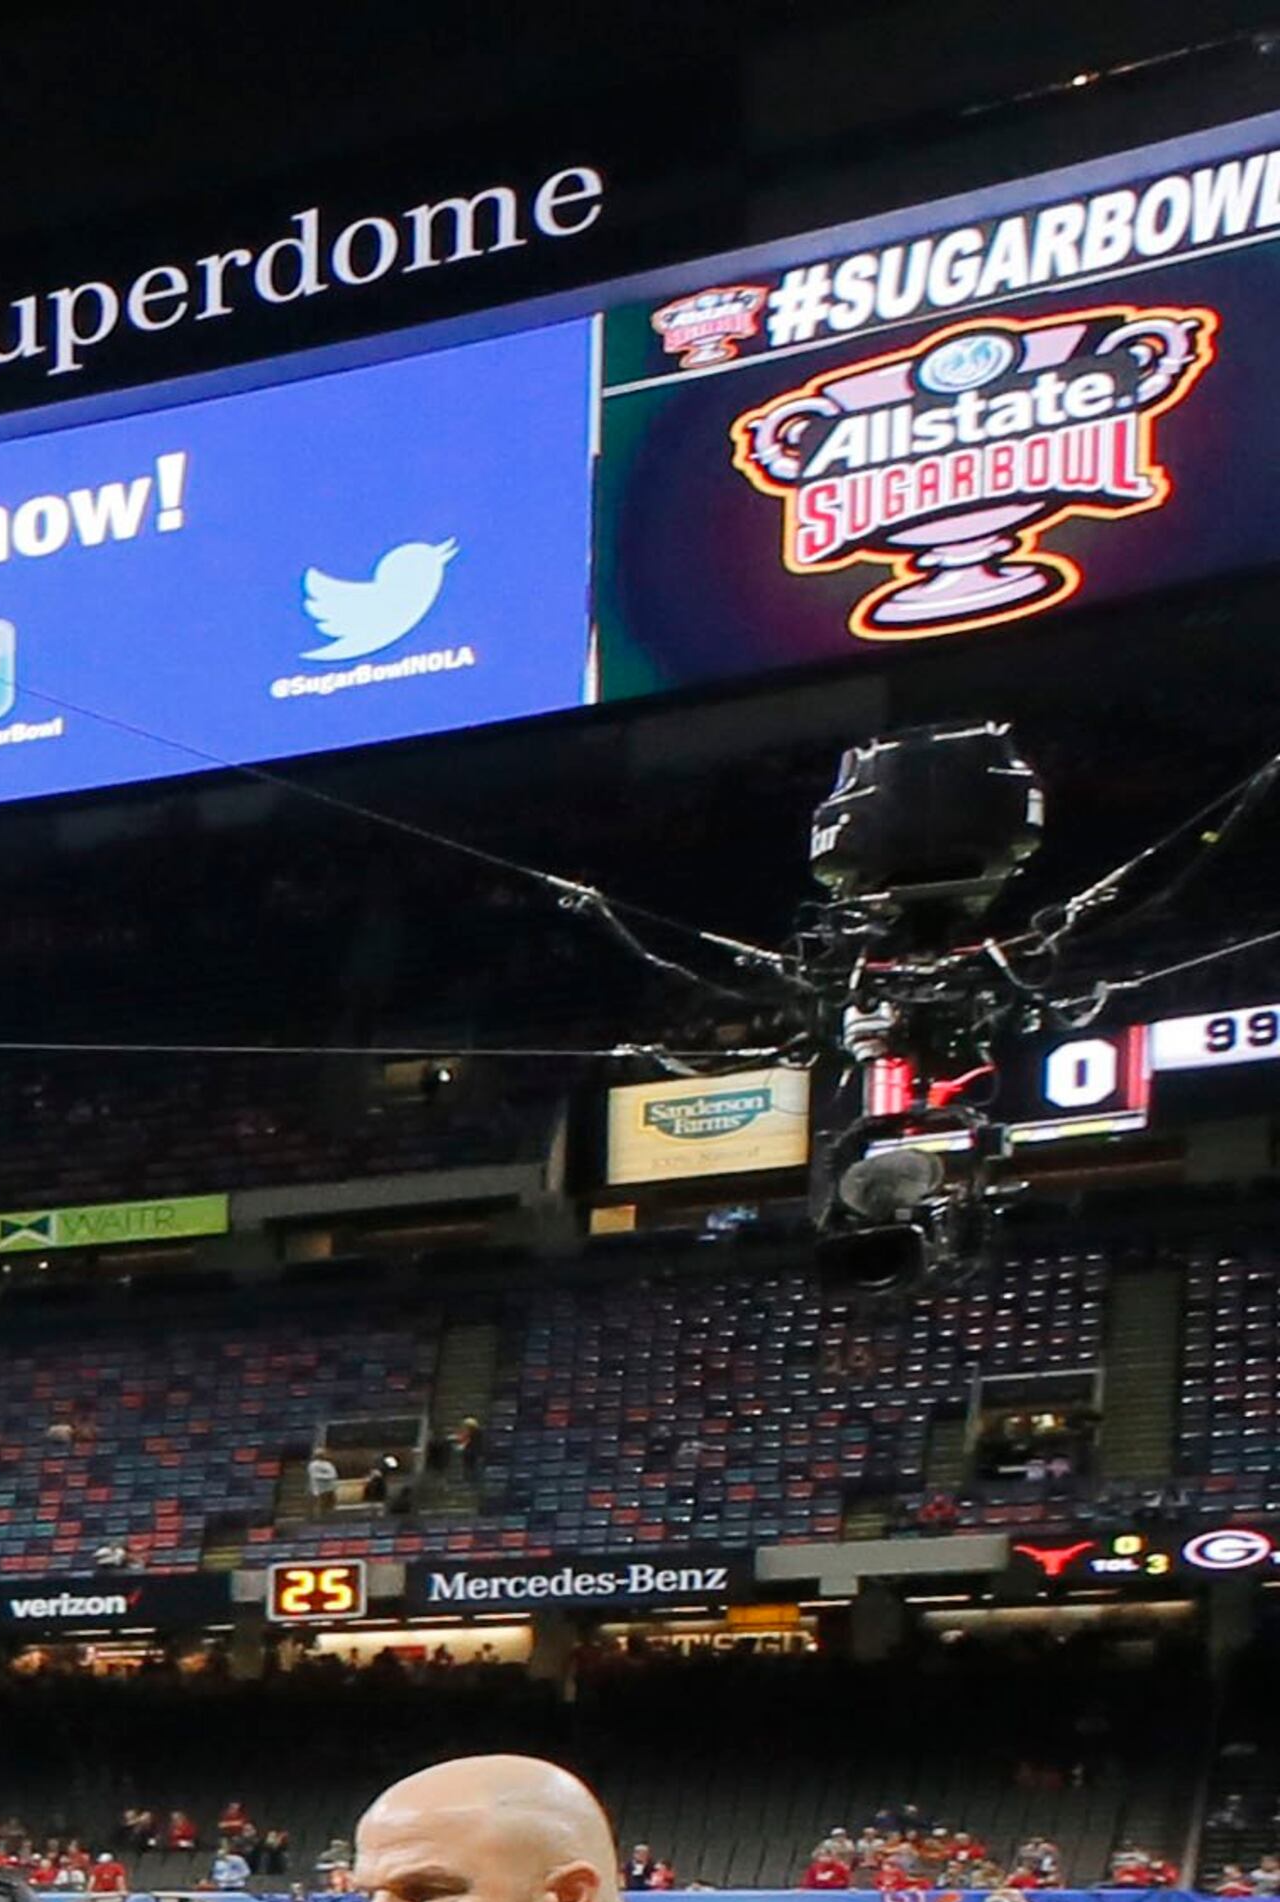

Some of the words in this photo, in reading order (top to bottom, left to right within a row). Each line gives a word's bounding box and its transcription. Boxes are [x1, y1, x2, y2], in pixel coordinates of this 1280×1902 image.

[1045, 1038, 1118, 1109] 0
[649, 1094, 764, 1122] Sanderson
[672, 1114, 742, 1135] Farms
[280, 1569, 354, 1614] 25
[430, 1564, 728, 1602] Mercedes-Benz
[11, 1593, 126, 1619] verizon
